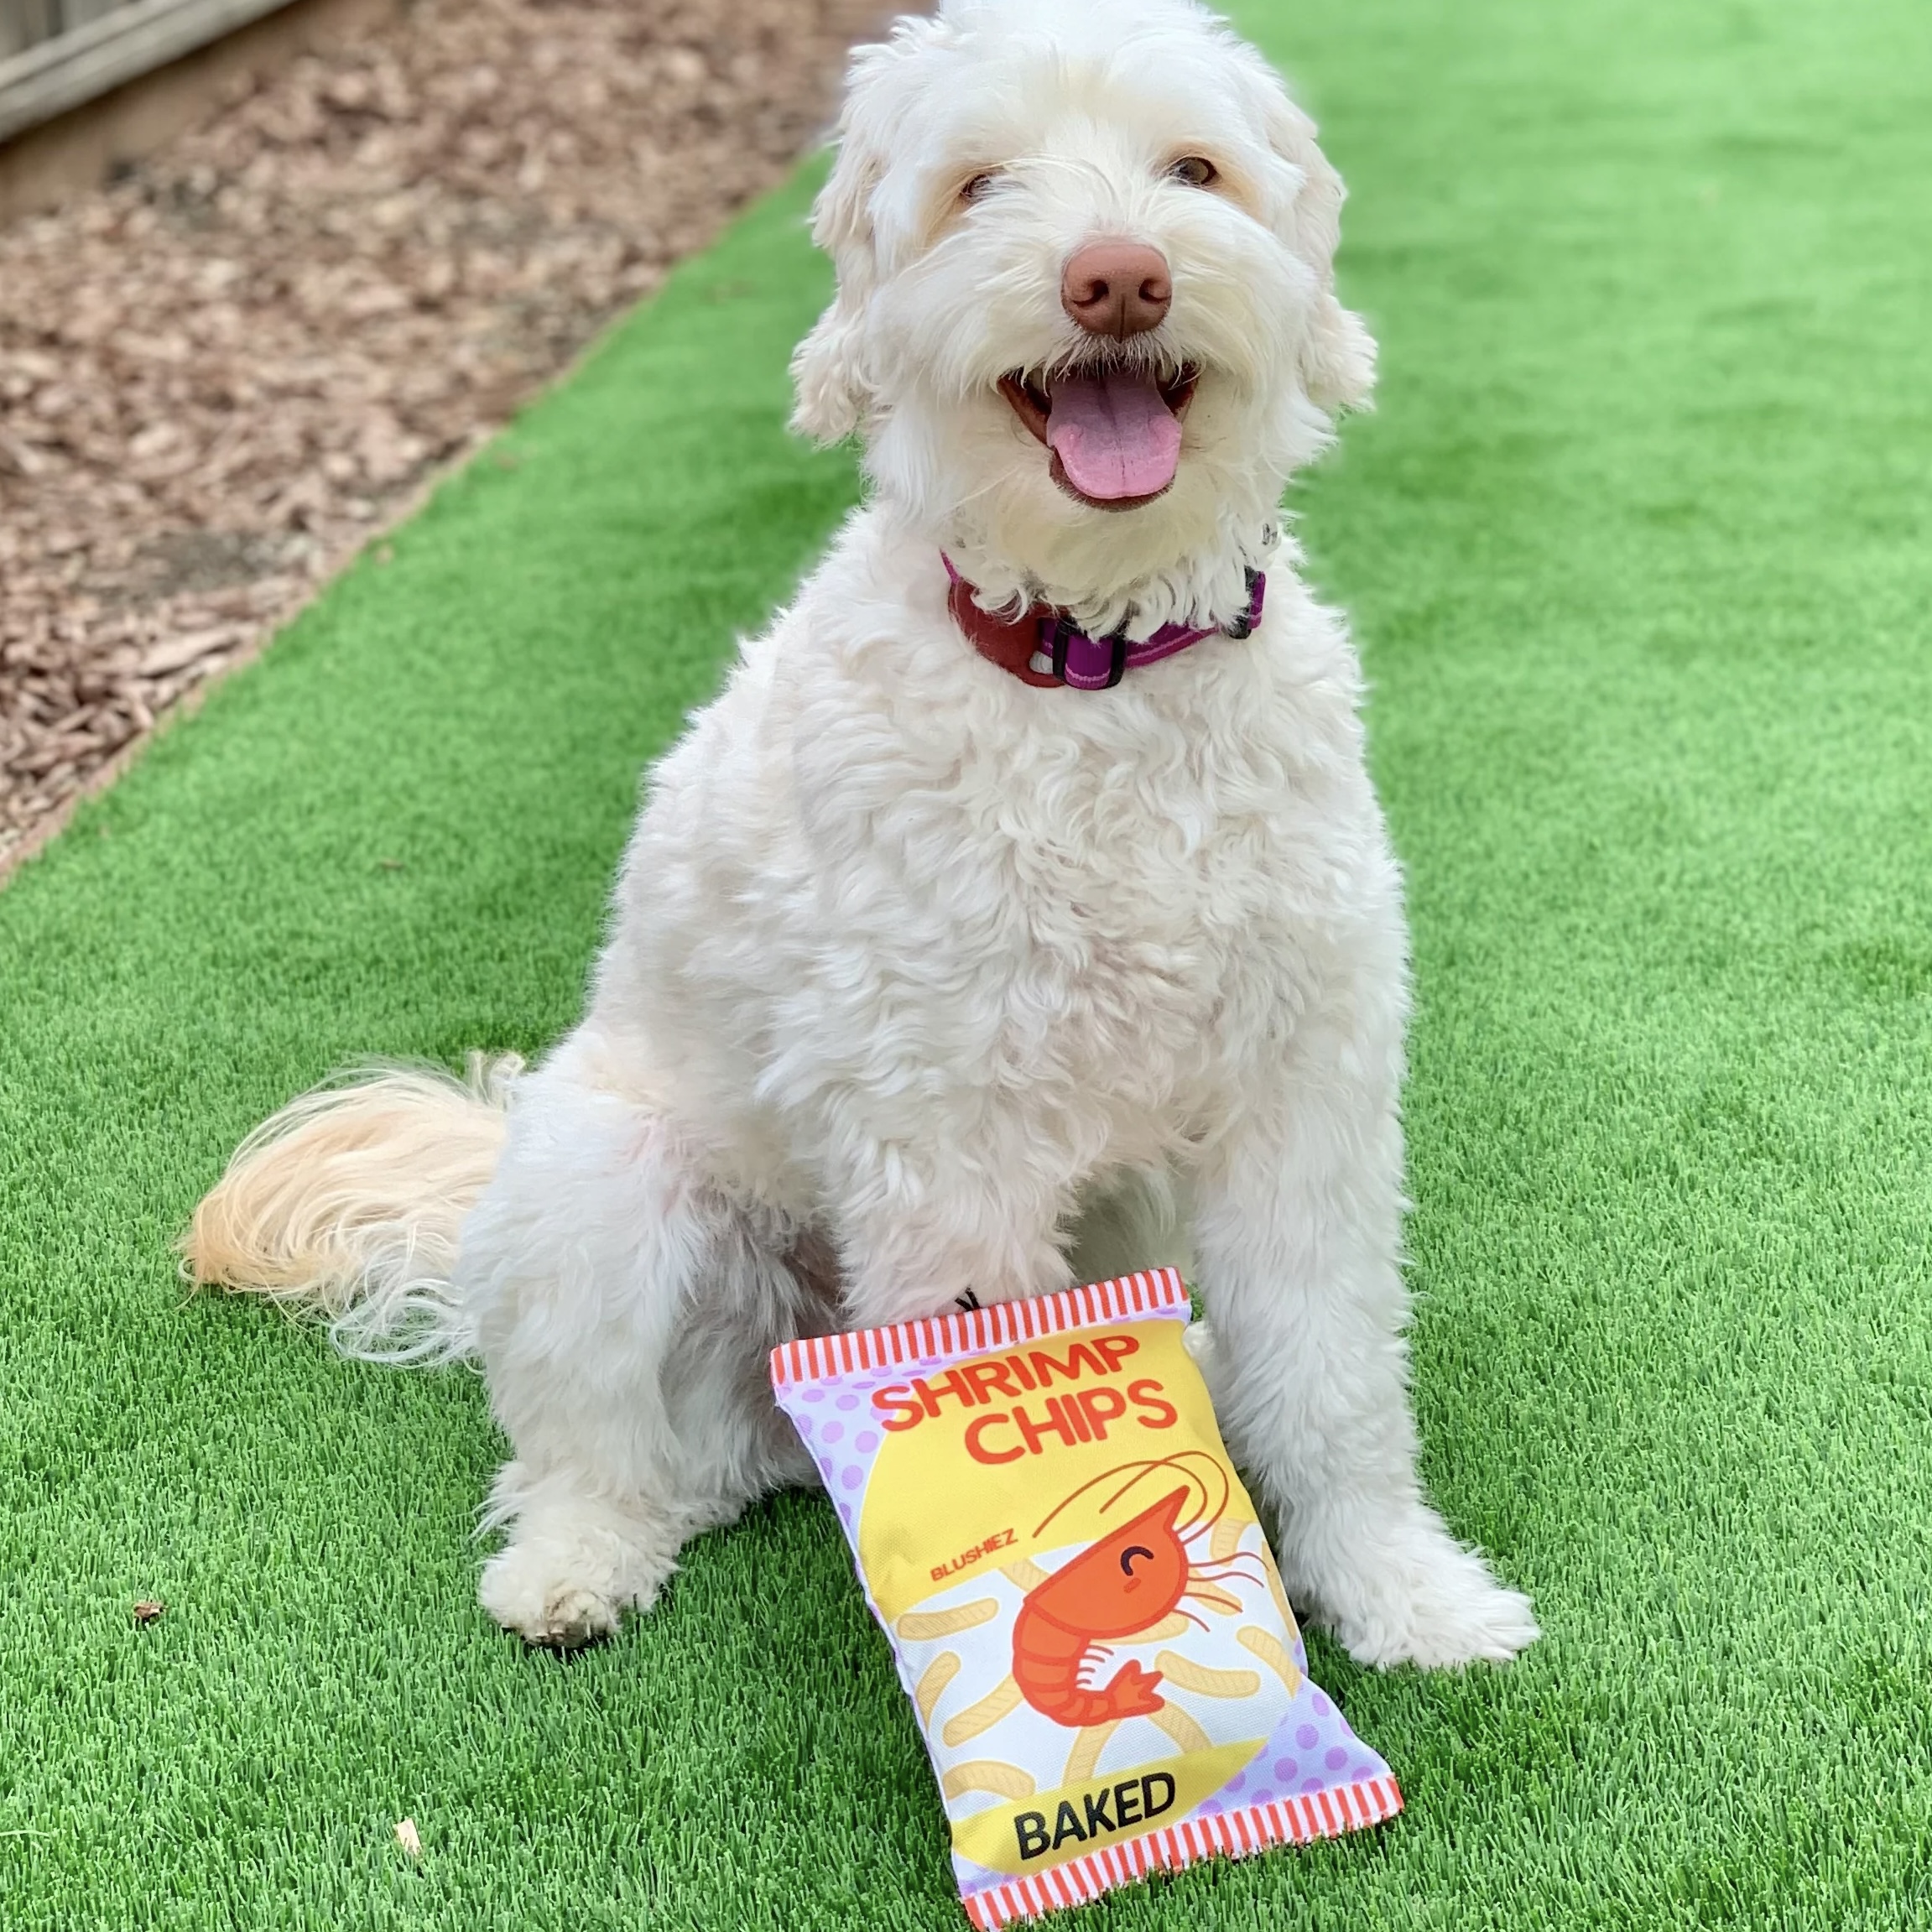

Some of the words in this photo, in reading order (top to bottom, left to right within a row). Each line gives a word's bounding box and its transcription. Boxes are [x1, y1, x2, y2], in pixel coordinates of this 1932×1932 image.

[872, 1335, 1139, 1431] SHRIMP
[965, 1379, 1178, 1465] CHIPS
[930, 1528, 1018, 1581] BLUSHIEZ
[1014, 1772, 1175, 1860] BAKED
